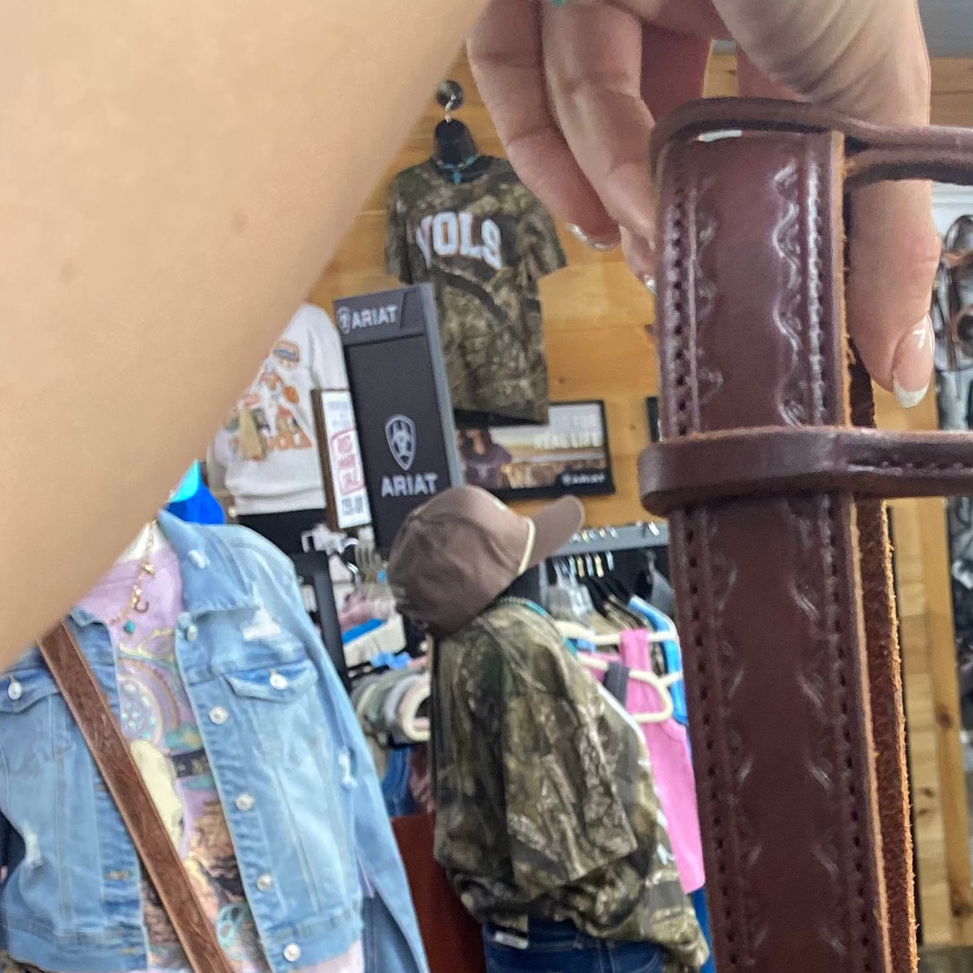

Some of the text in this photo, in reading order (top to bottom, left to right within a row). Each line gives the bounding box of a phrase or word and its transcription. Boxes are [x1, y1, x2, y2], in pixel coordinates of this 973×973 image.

[415, 210, 503, 270] VOLS
[352, 305, 399, 330] ARIAT
[381, 472, 438, 498] ARIAT
